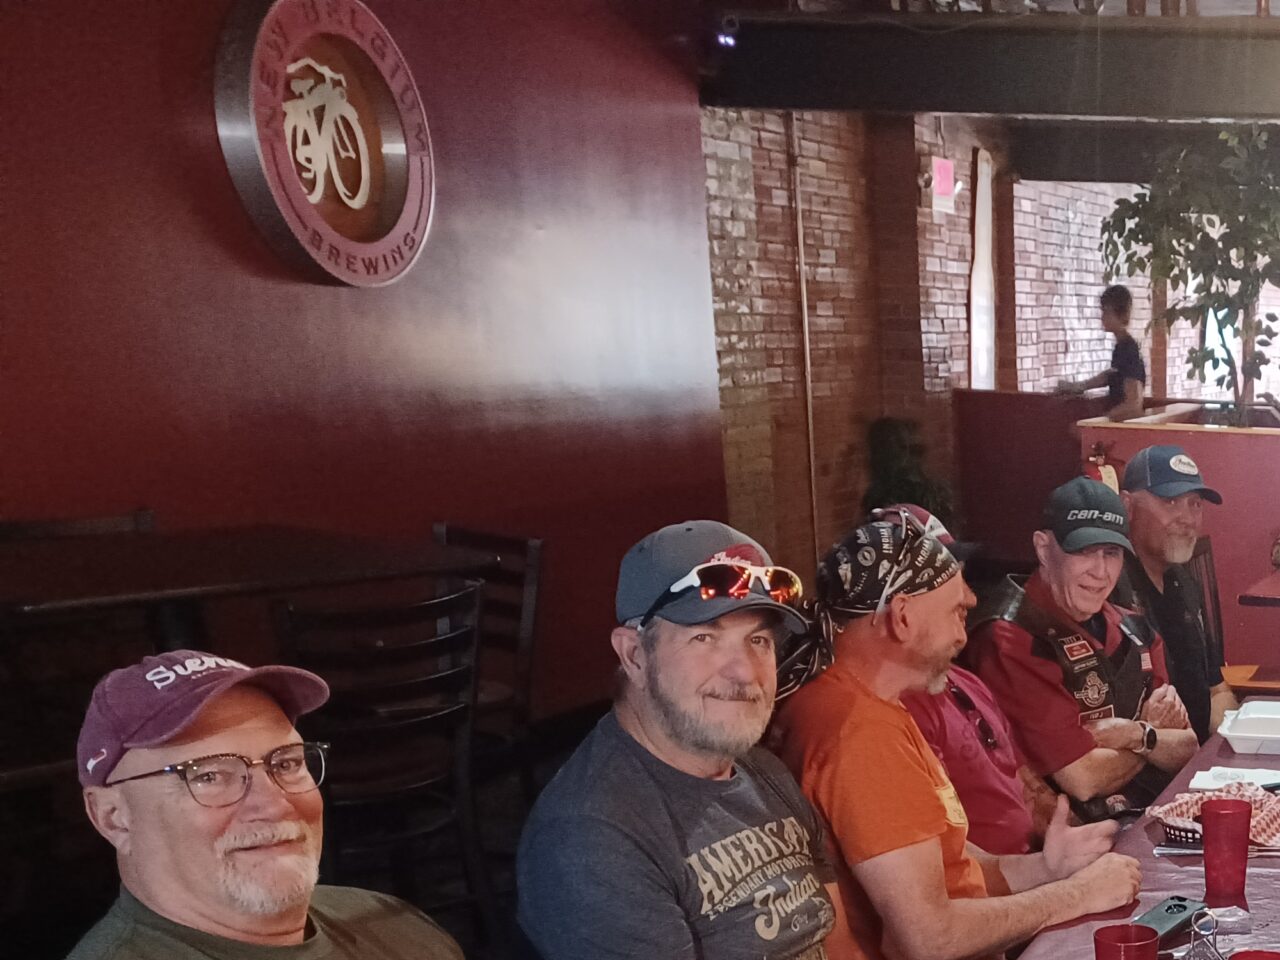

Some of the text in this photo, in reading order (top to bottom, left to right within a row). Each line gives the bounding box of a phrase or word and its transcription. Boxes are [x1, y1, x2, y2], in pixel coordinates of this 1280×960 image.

[311, 231, 416, 276] BREWING
[1066, 509, 1125, 526] can-am
[753, 872, 821, 941] Indian
